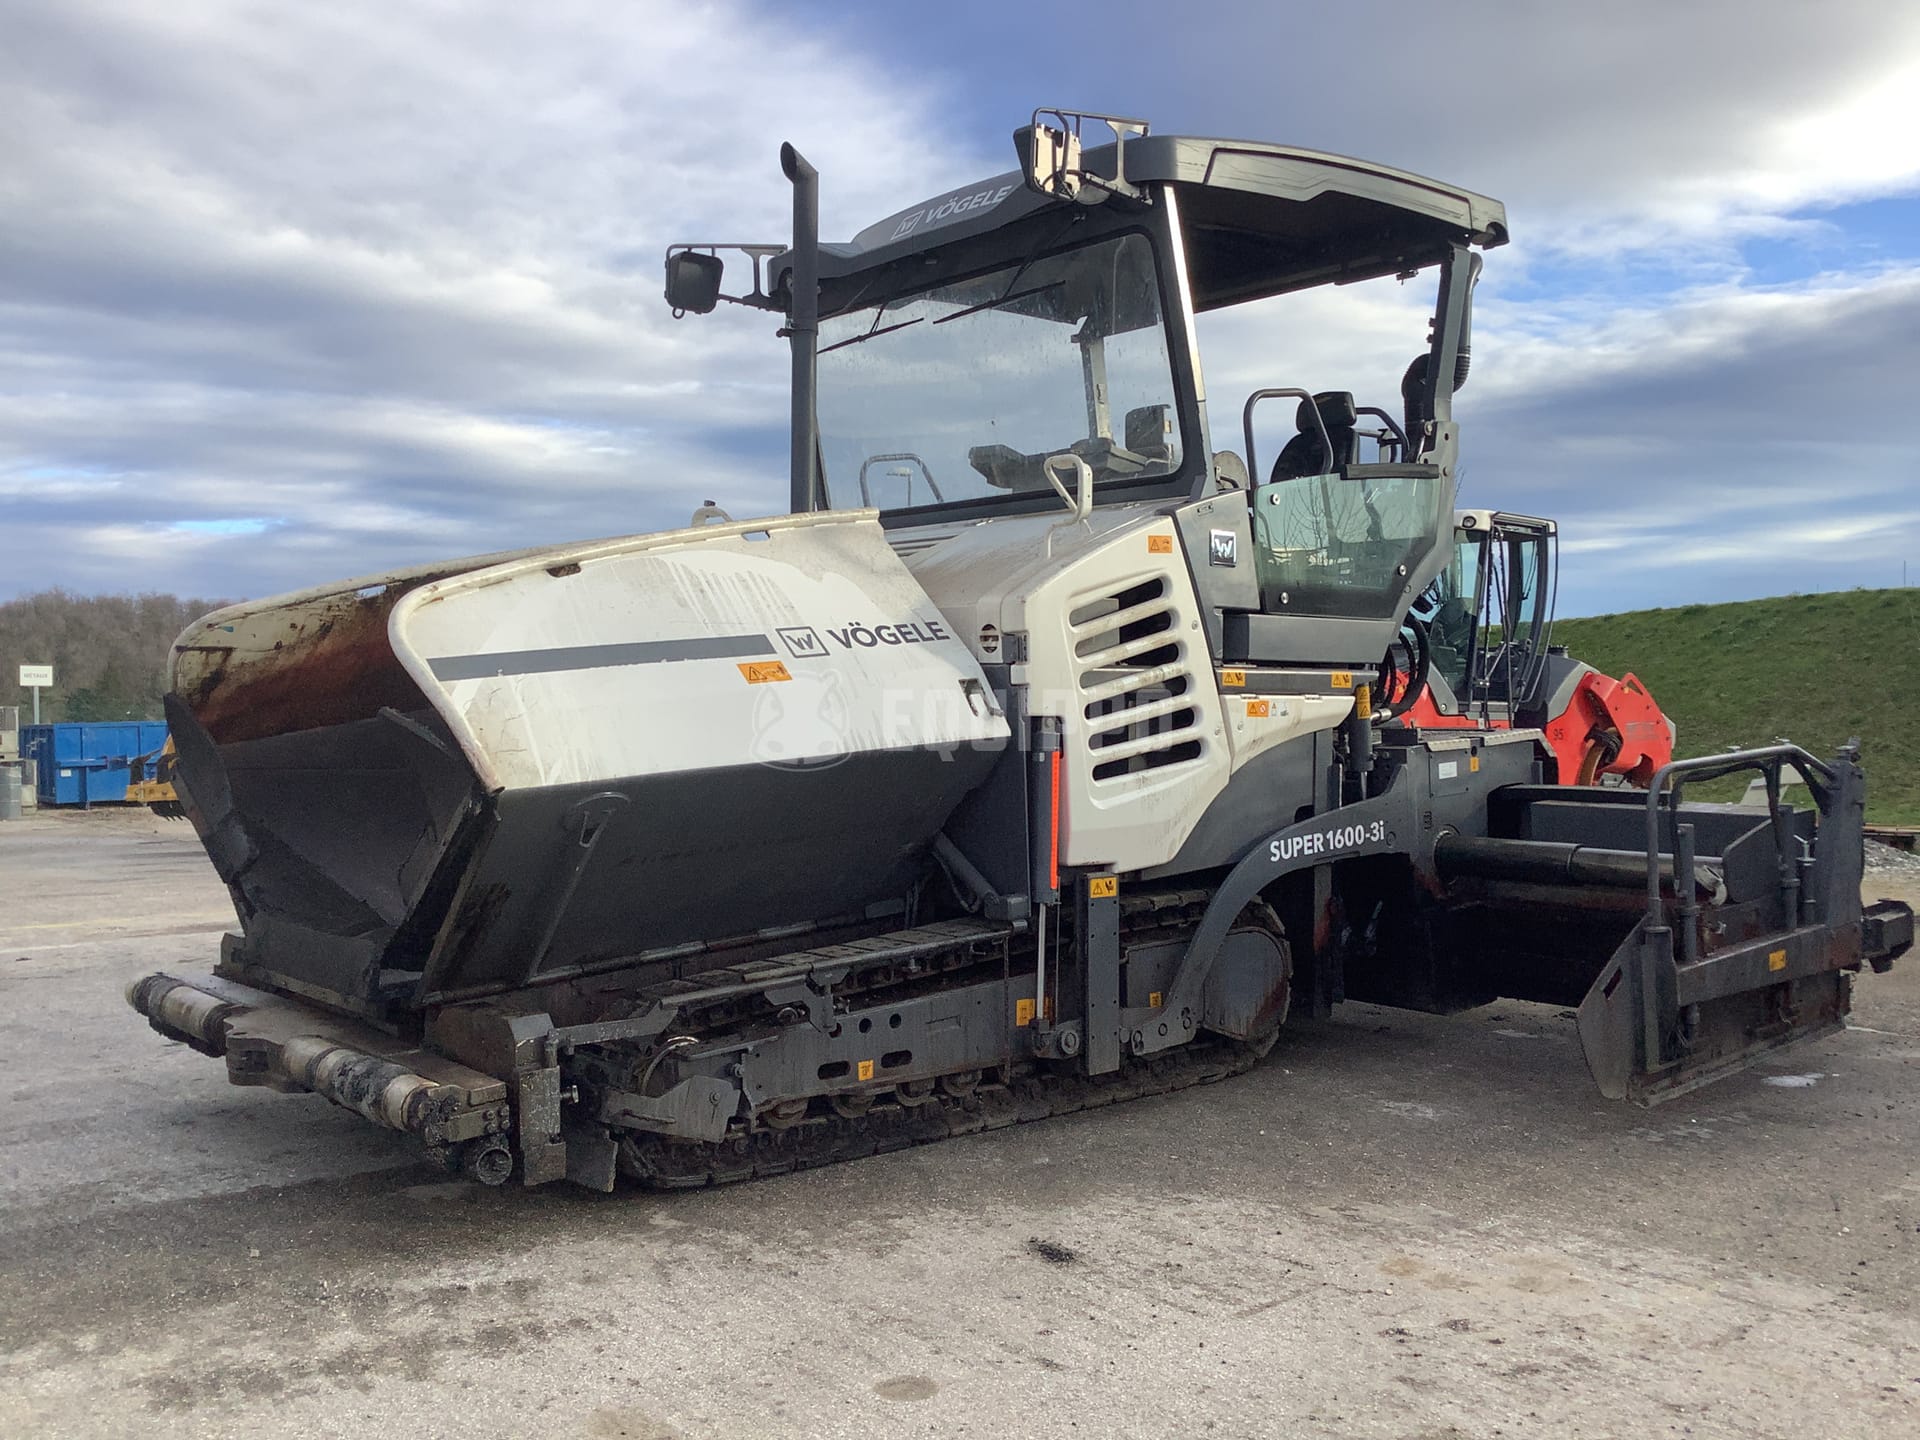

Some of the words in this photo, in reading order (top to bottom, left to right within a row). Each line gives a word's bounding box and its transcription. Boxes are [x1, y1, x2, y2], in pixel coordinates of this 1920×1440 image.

[925, 184, 1012, 224] VÖGELE
[825, 621, 951, 649] VÖGELE
[1270, 833, 1325, 862] SUPER
[1326, 820, 1385, 850] 1600-3i
